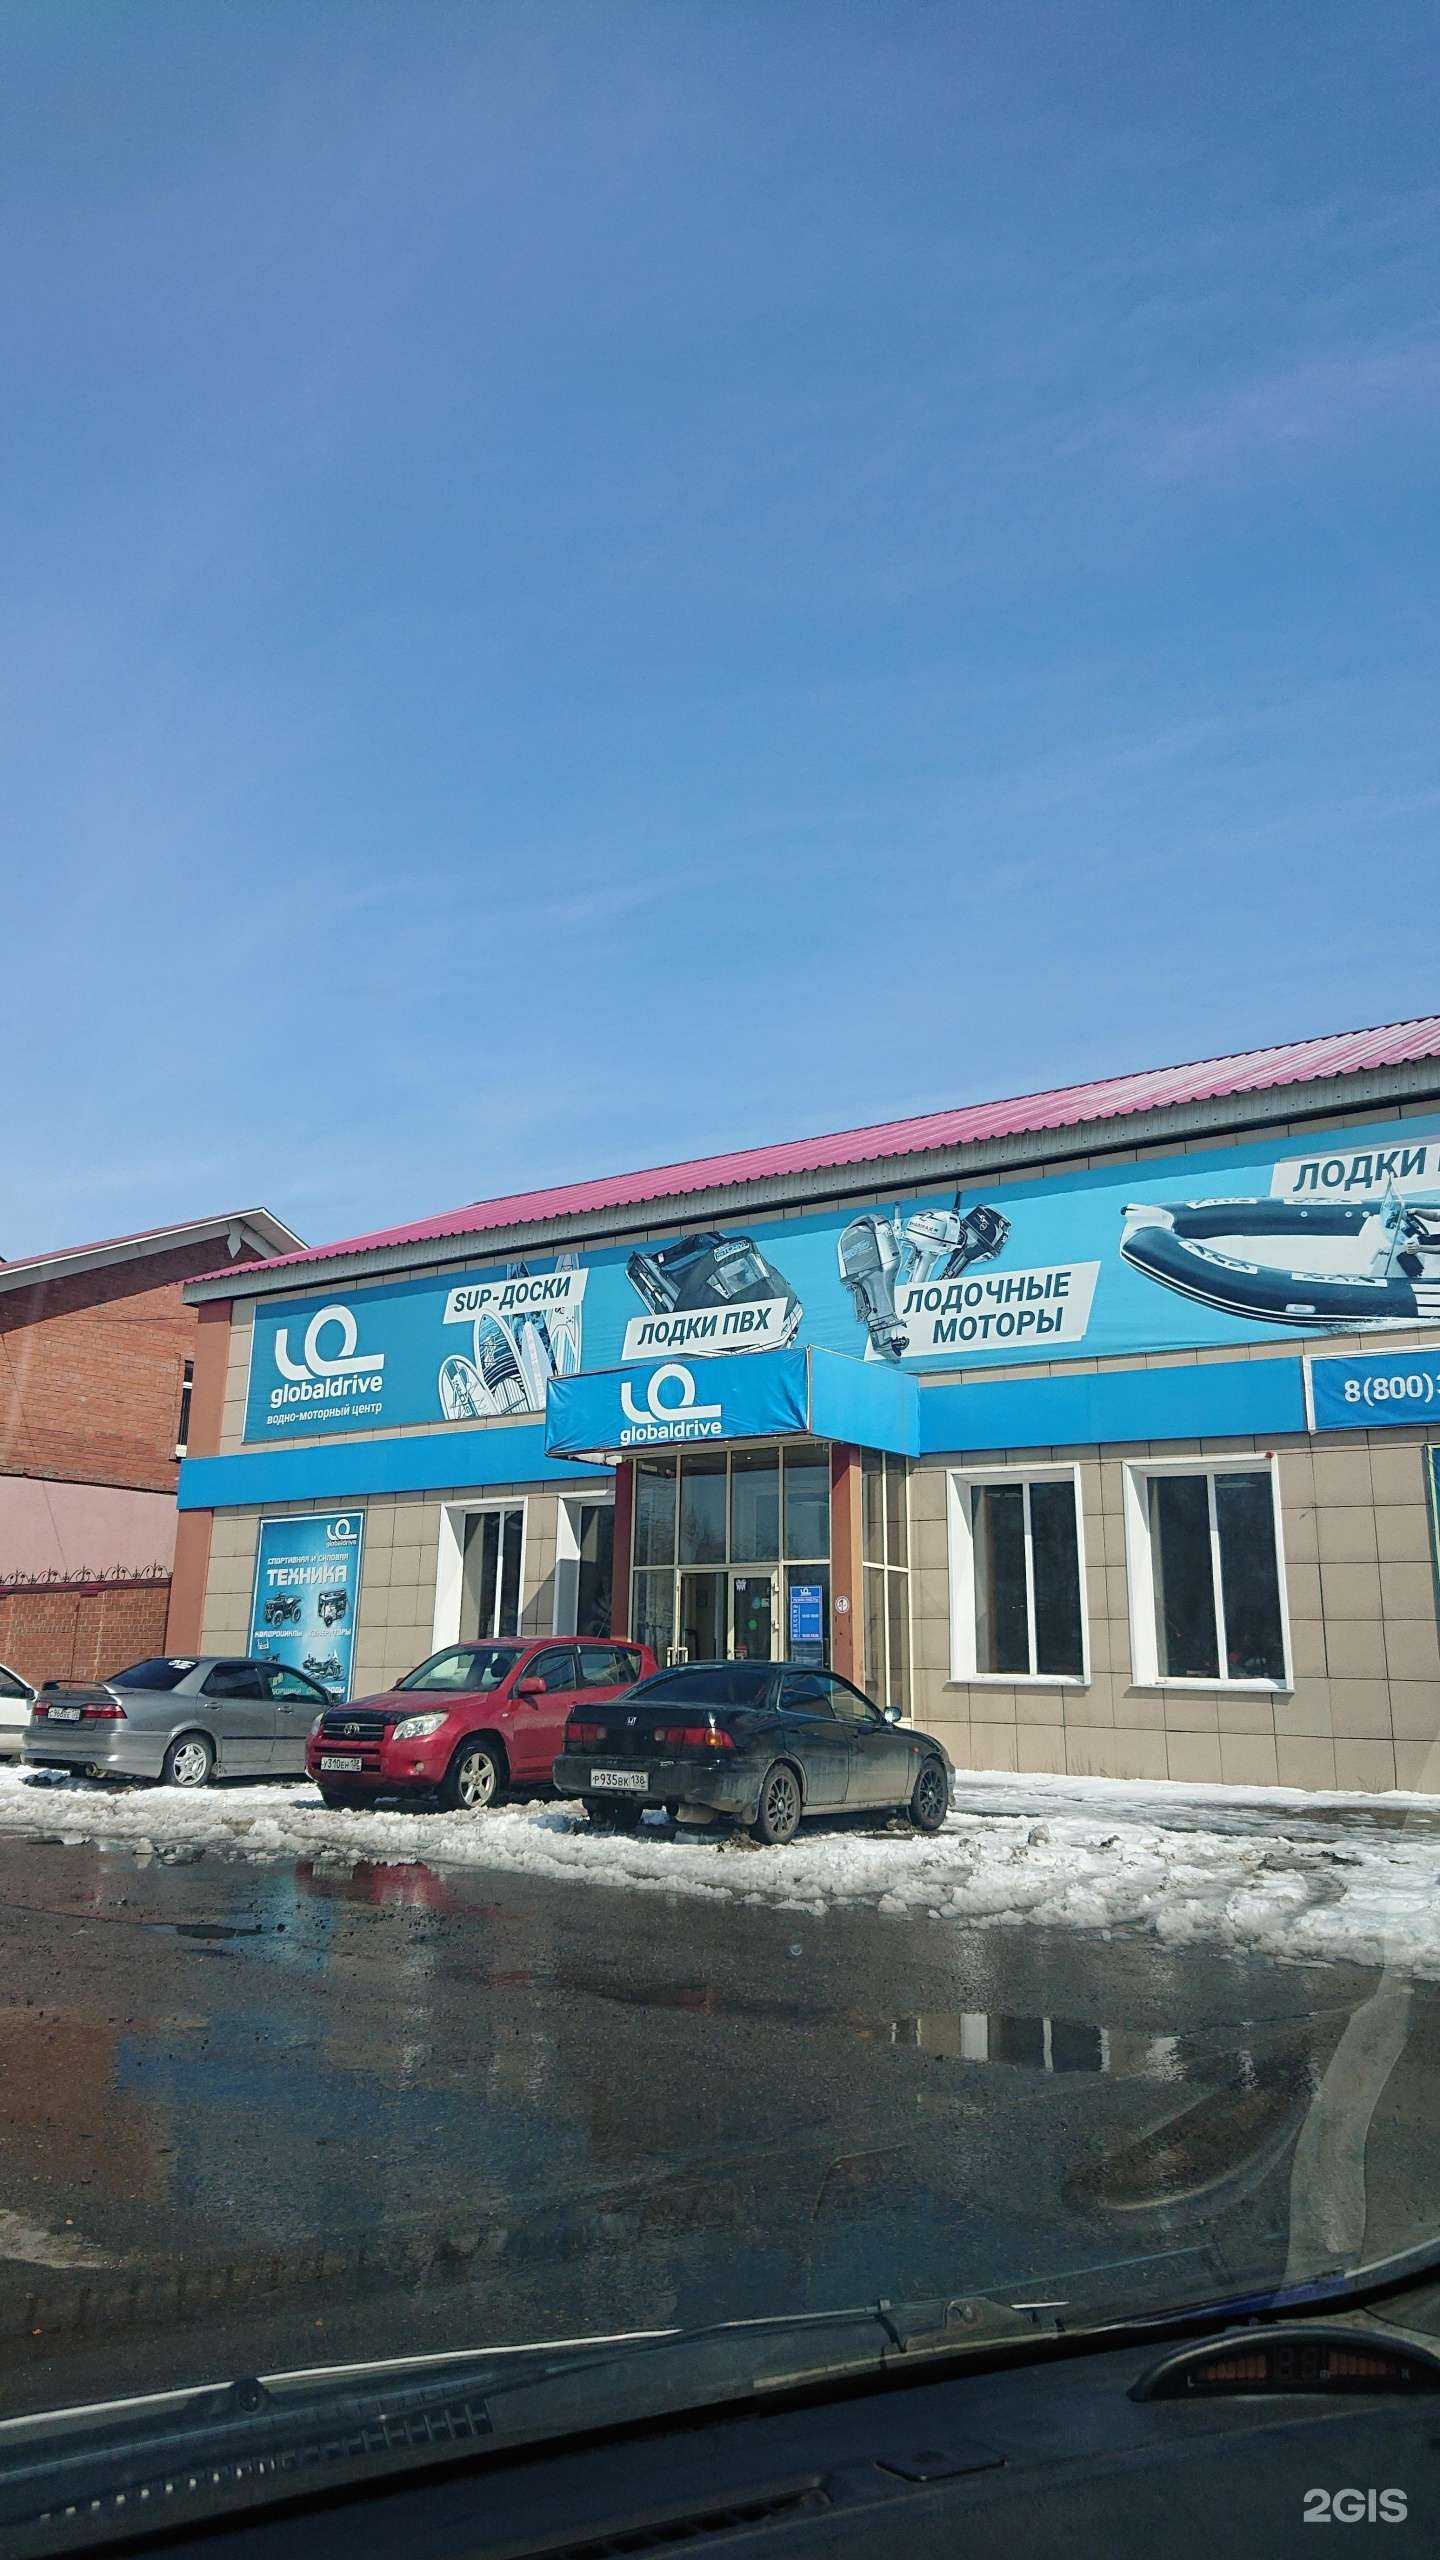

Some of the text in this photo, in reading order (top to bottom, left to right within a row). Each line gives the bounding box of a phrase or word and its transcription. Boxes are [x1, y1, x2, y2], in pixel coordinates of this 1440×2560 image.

[1292, 1147, 1427, 1192] ЛОДКИ
[453, 1276, 572, 1313] SUP-ДОСКИ
[903, 1272, 1072, 1314] ЛОДОЧНЫЕ
[637, 1308, 771, 1346] ЛОДКИ ПВХ
[932, 1307, 1064, 1344] МОТОРЫ
[270, 1374, 383, 1409] globaldrive
[266, 1400, 382, 1425] водно-моторный центр
[620, 1420, 722, 1447] globaldrive
[266, 1565, 348, 1586] ТЕХНИКА
